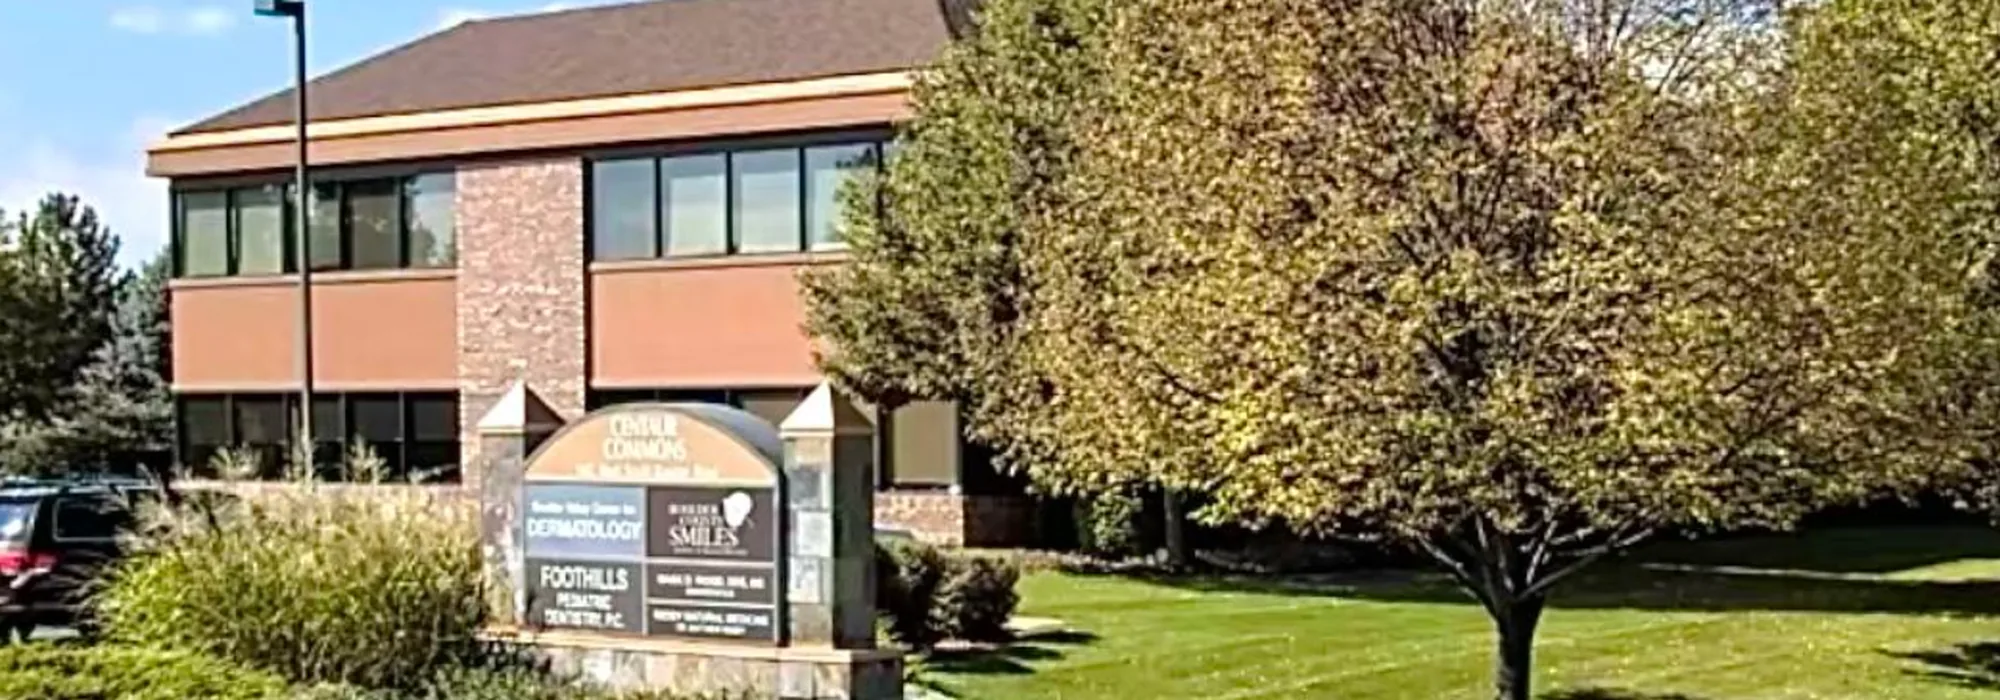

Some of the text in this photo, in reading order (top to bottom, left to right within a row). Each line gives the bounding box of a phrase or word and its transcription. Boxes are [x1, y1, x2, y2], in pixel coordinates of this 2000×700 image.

[609, 413, 678, 437] CENTAUR
[602, 436, 687, 462] COMMONS
[527, 518, 642, 540] DERMATOLOGY
[669, 525, 740, 546] SMILES
[541, 565, 629, 591] FOOTHILLS
